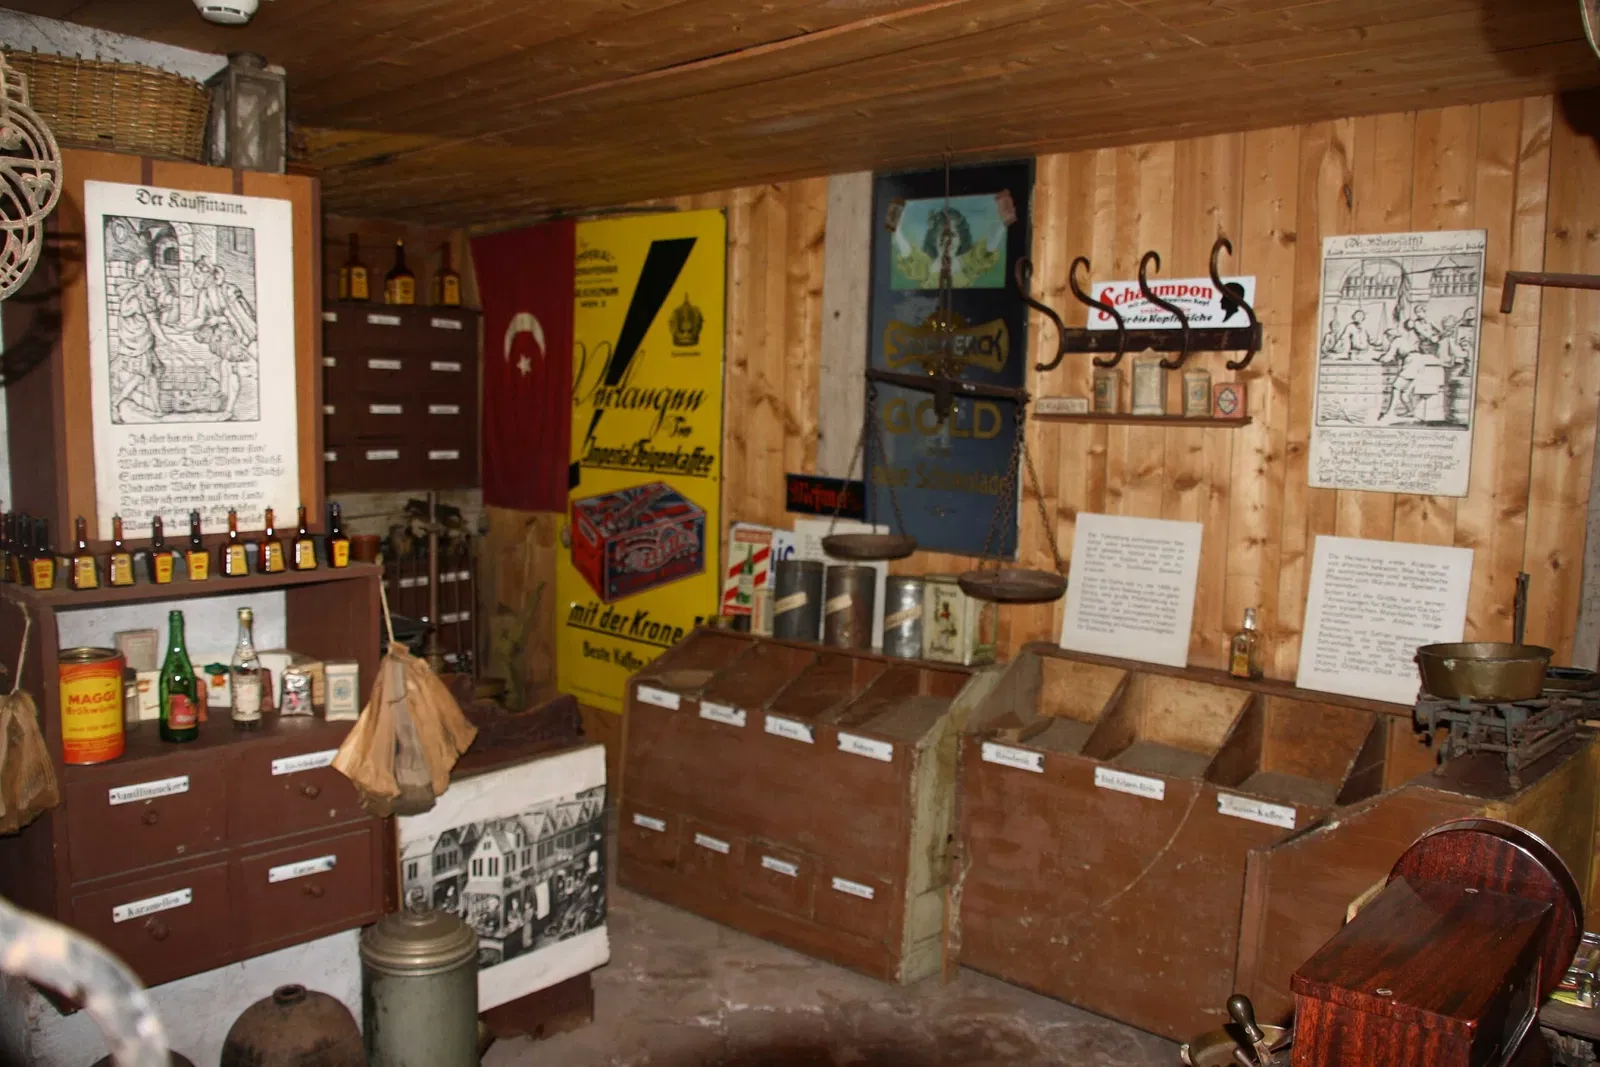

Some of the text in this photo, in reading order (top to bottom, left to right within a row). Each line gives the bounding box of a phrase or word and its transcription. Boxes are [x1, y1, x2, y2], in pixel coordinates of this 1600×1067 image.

[135, 188, 164, 206] Der
[882, 397, 1003, 439] GOLD
[567, 601, 685, 644] mit der Krone
[68, 690, 117, 705] MAGGI
